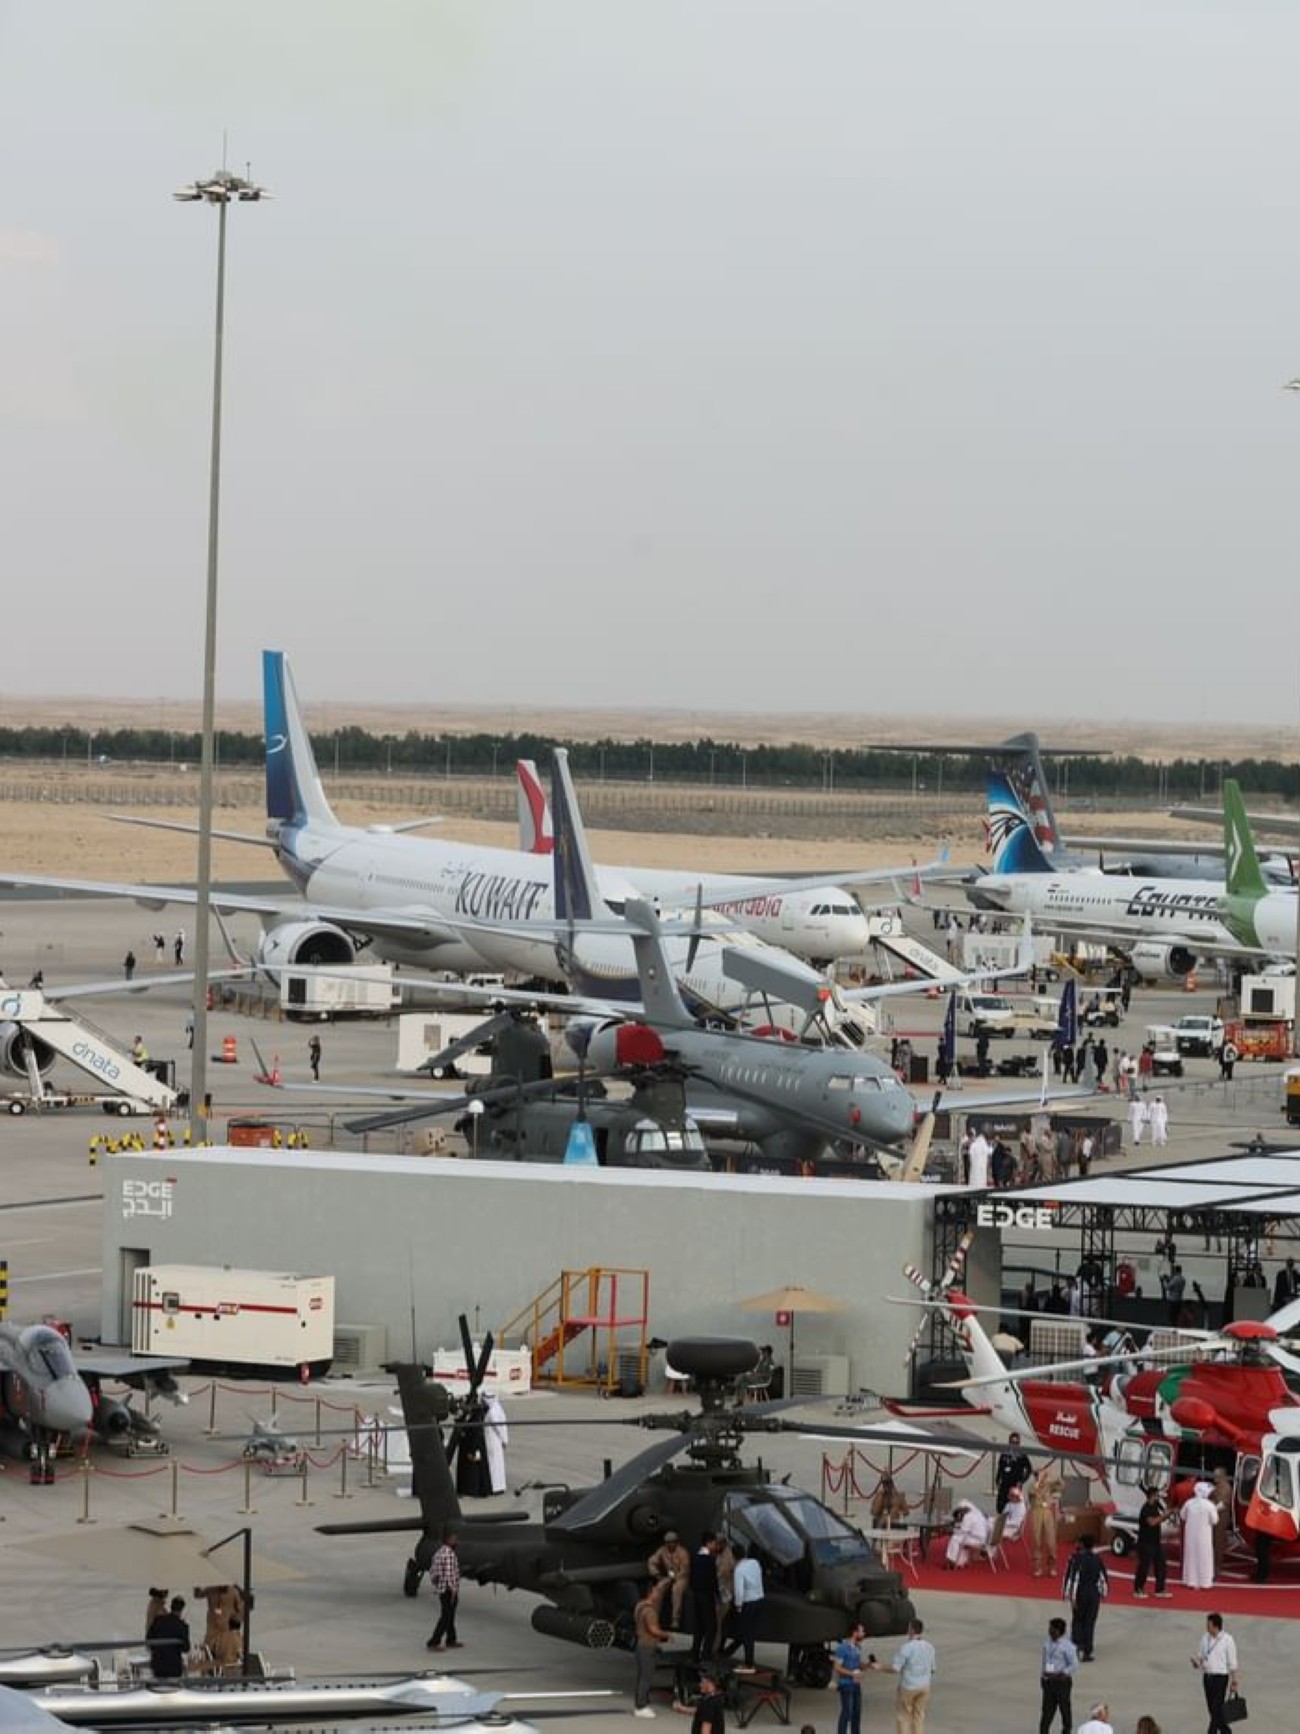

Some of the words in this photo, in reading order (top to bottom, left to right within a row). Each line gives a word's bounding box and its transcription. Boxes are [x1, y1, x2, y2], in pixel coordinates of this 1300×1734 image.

[455, 872, 549, 920] KUWAIT
[1126, 886, 1219, 920] EGYPTA
[72, 1041, 120, 1080] dnata
[122, 1180, 172, 1199] EDGE
[977, 1204, 1053, 1230] EDGE
[1049, 1423, 1081, 1441] RESCUE
